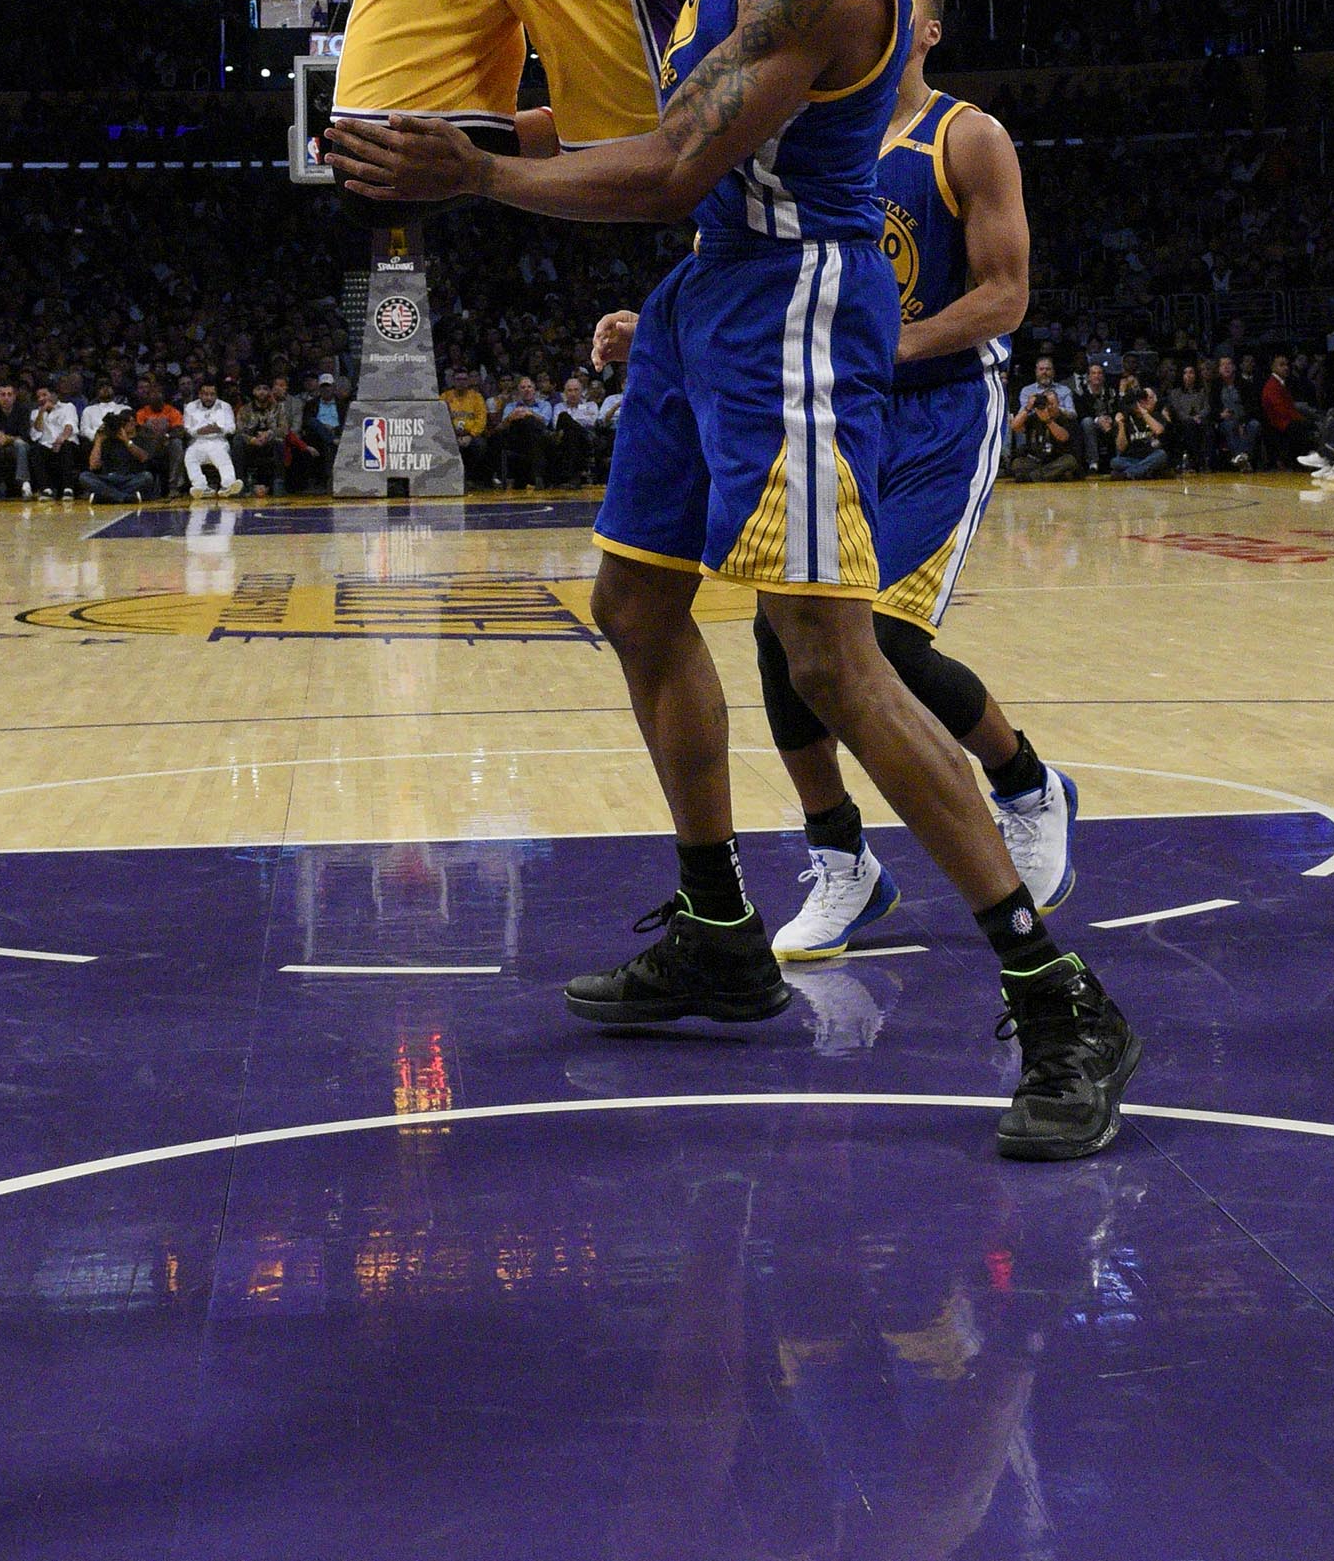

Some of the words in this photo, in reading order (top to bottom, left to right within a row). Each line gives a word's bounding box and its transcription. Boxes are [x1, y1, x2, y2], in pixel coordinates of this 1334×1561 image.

[376, 261, 415, 273] SPALDING
[388, 418, 411, 436] THIS
[412, 418, 425, 436] IS
[388, 436, 413, 454] WHY
[388, 453, 407, 470] WE
[407, 453, 433, 471] PLAY
